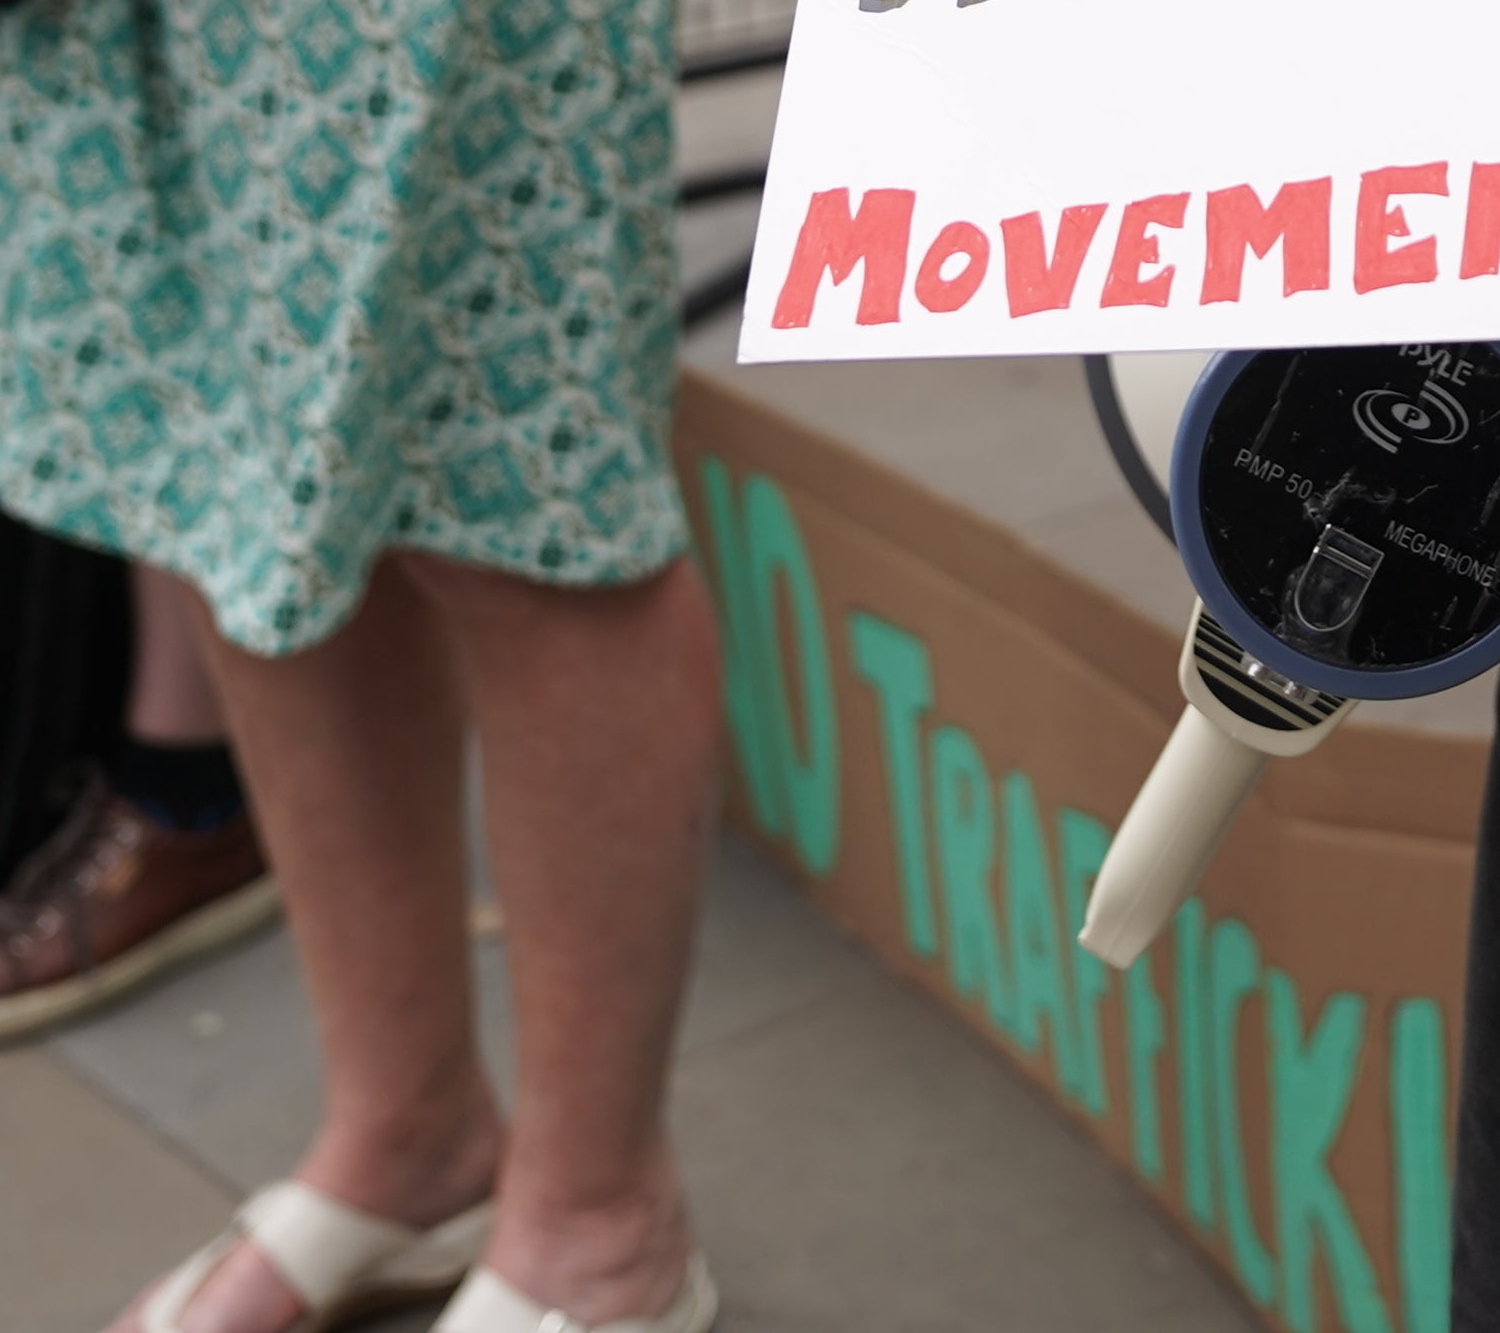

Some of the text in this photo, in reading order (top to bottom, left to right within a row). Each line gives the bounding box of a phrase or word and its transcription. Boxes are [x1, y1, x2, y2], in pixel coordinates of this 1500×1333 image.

[1398, 342, 1475, 388] PYLE
[1232, 446, 1286, 484] PMP
[1382, 518, 1498, 589] MEGAPHONE
[846, 603, 1457, 1333] TRAFFICKI
